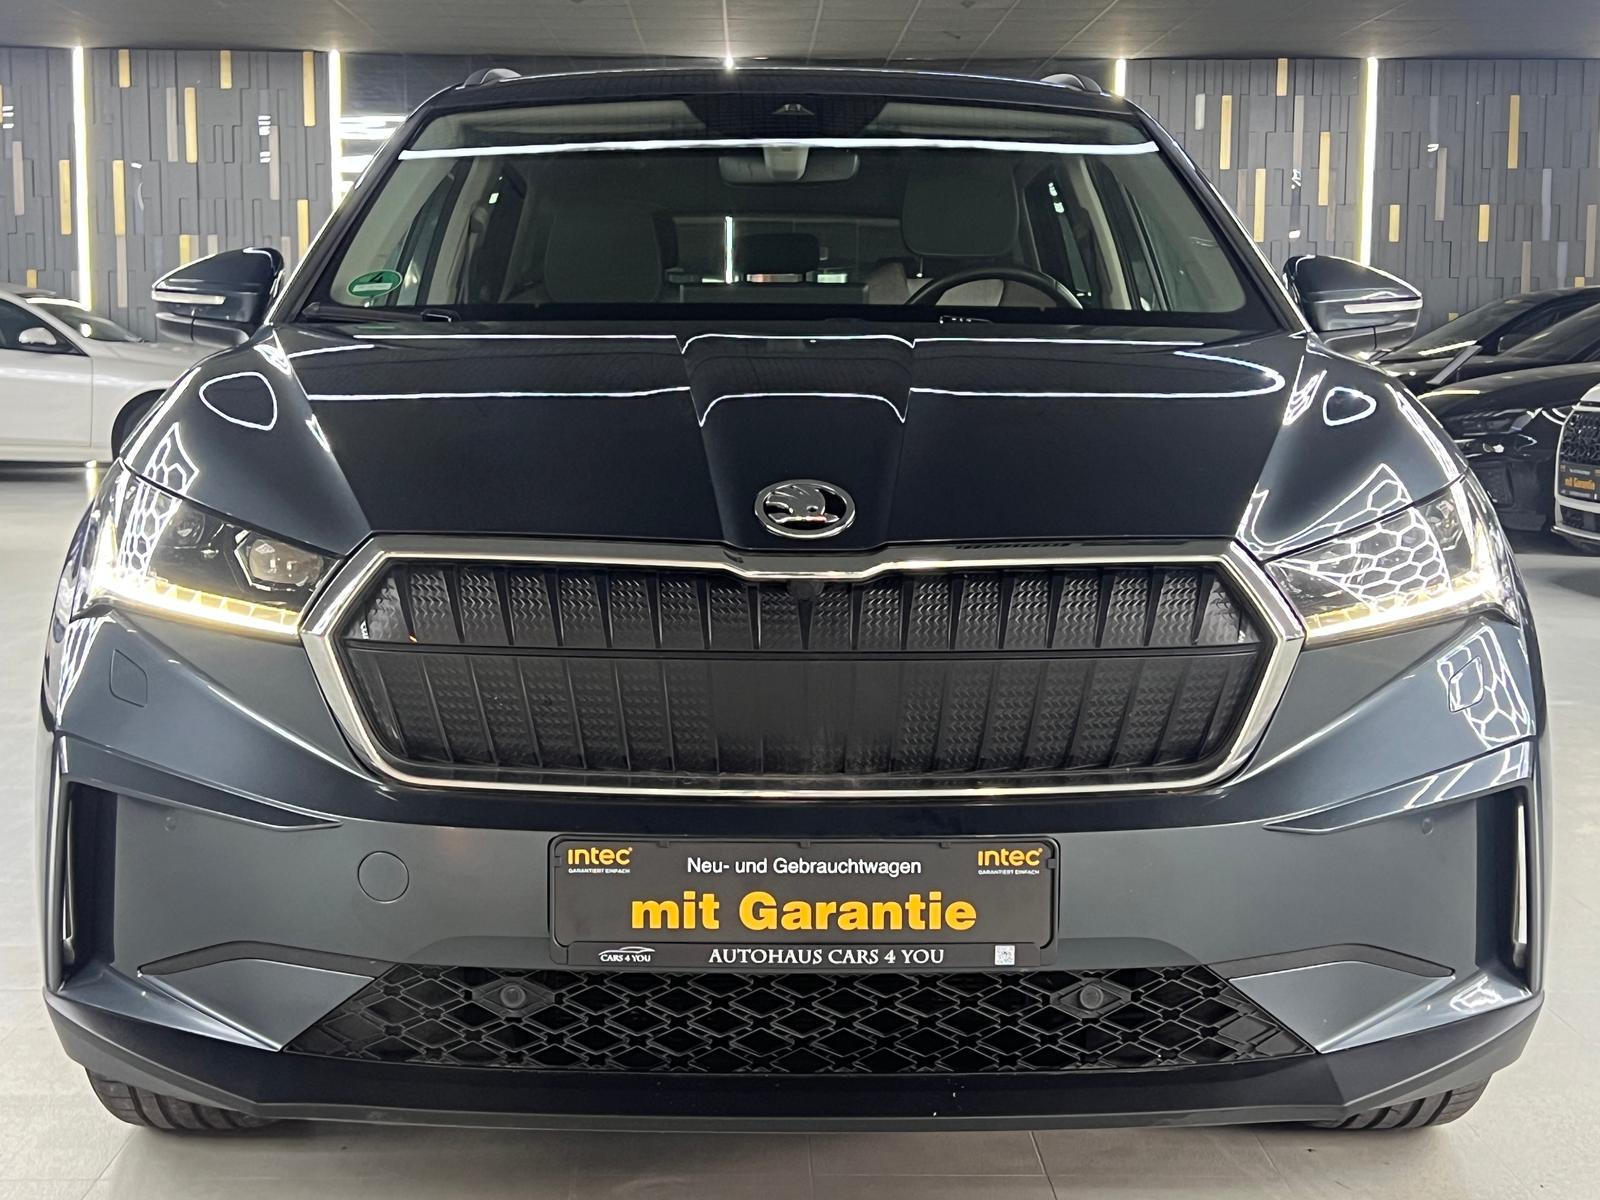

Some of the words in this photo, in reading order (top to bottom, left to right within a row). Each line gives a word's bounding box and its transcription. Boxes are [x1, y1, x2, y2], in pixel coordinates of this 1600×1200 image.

[687, 857, 730, 873] Neu-
[735, 857, 768, 873] und
[773, 857, 922, 878] Gebrauchtwagen
[631, 890, 720, 930] mit
[739, 891, 977, 931] Garantie
[600, 954, 624, 962] CARS
[624, 954, 631, 962] 4
[631, 954, 651, 962] YOU
[708, 948, 823, 964] AUTOHAUS
[828, 948, 879, 964] CARS
[884, 948, 896, 964] 4
[902, 948, 944, 964] YOU
